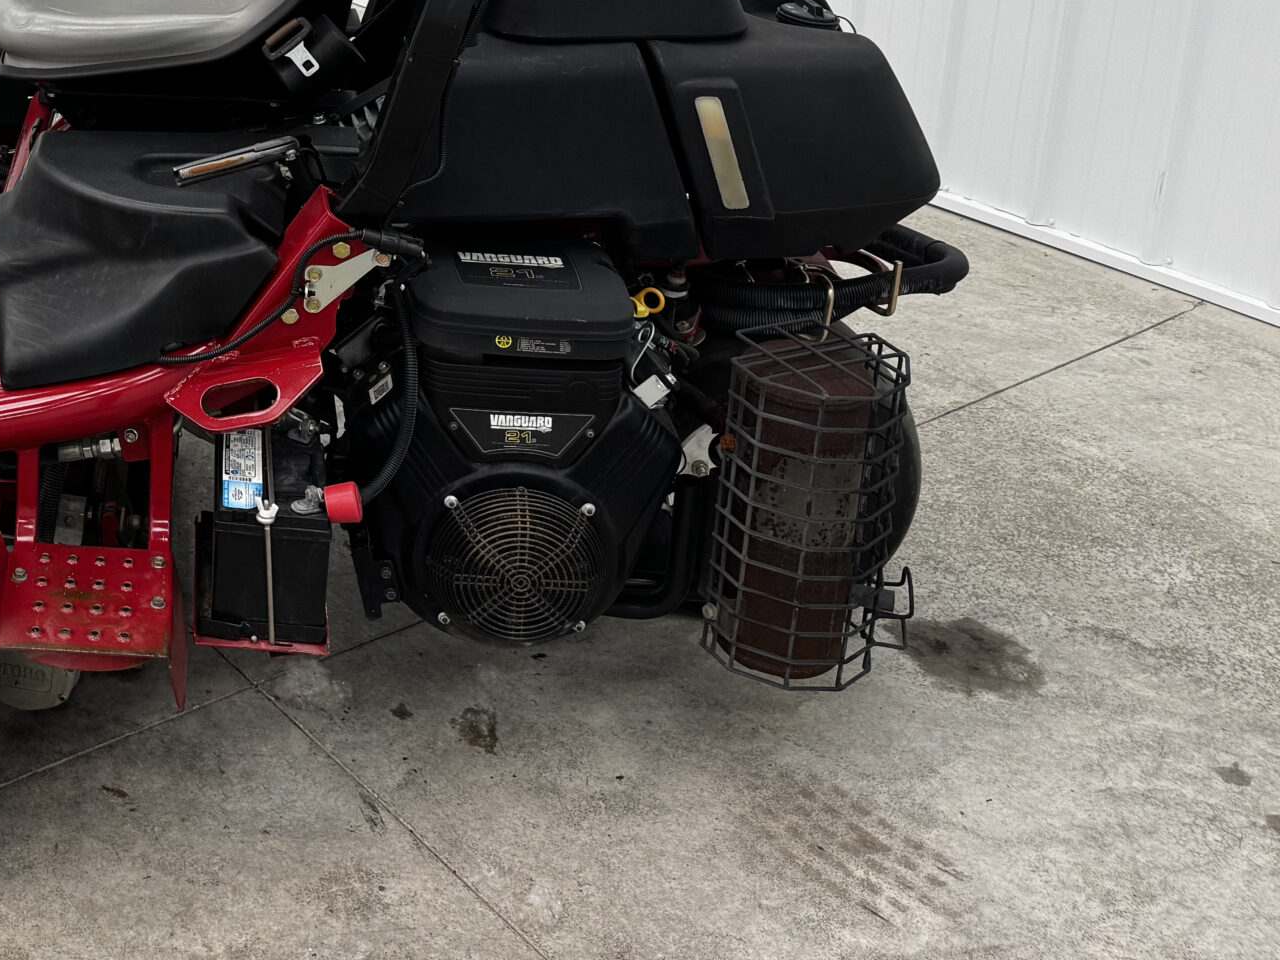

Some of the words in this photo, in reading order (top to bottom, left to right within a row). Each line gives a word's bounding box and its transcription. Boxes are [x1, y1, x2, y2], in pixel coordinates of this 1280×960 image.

[457, 251, 564, 265] VANGUARD
[489, 267, 535, 279] 21
[489, 413, 553, 428] VANGUARD
[504, 430, 533, 444] 21
